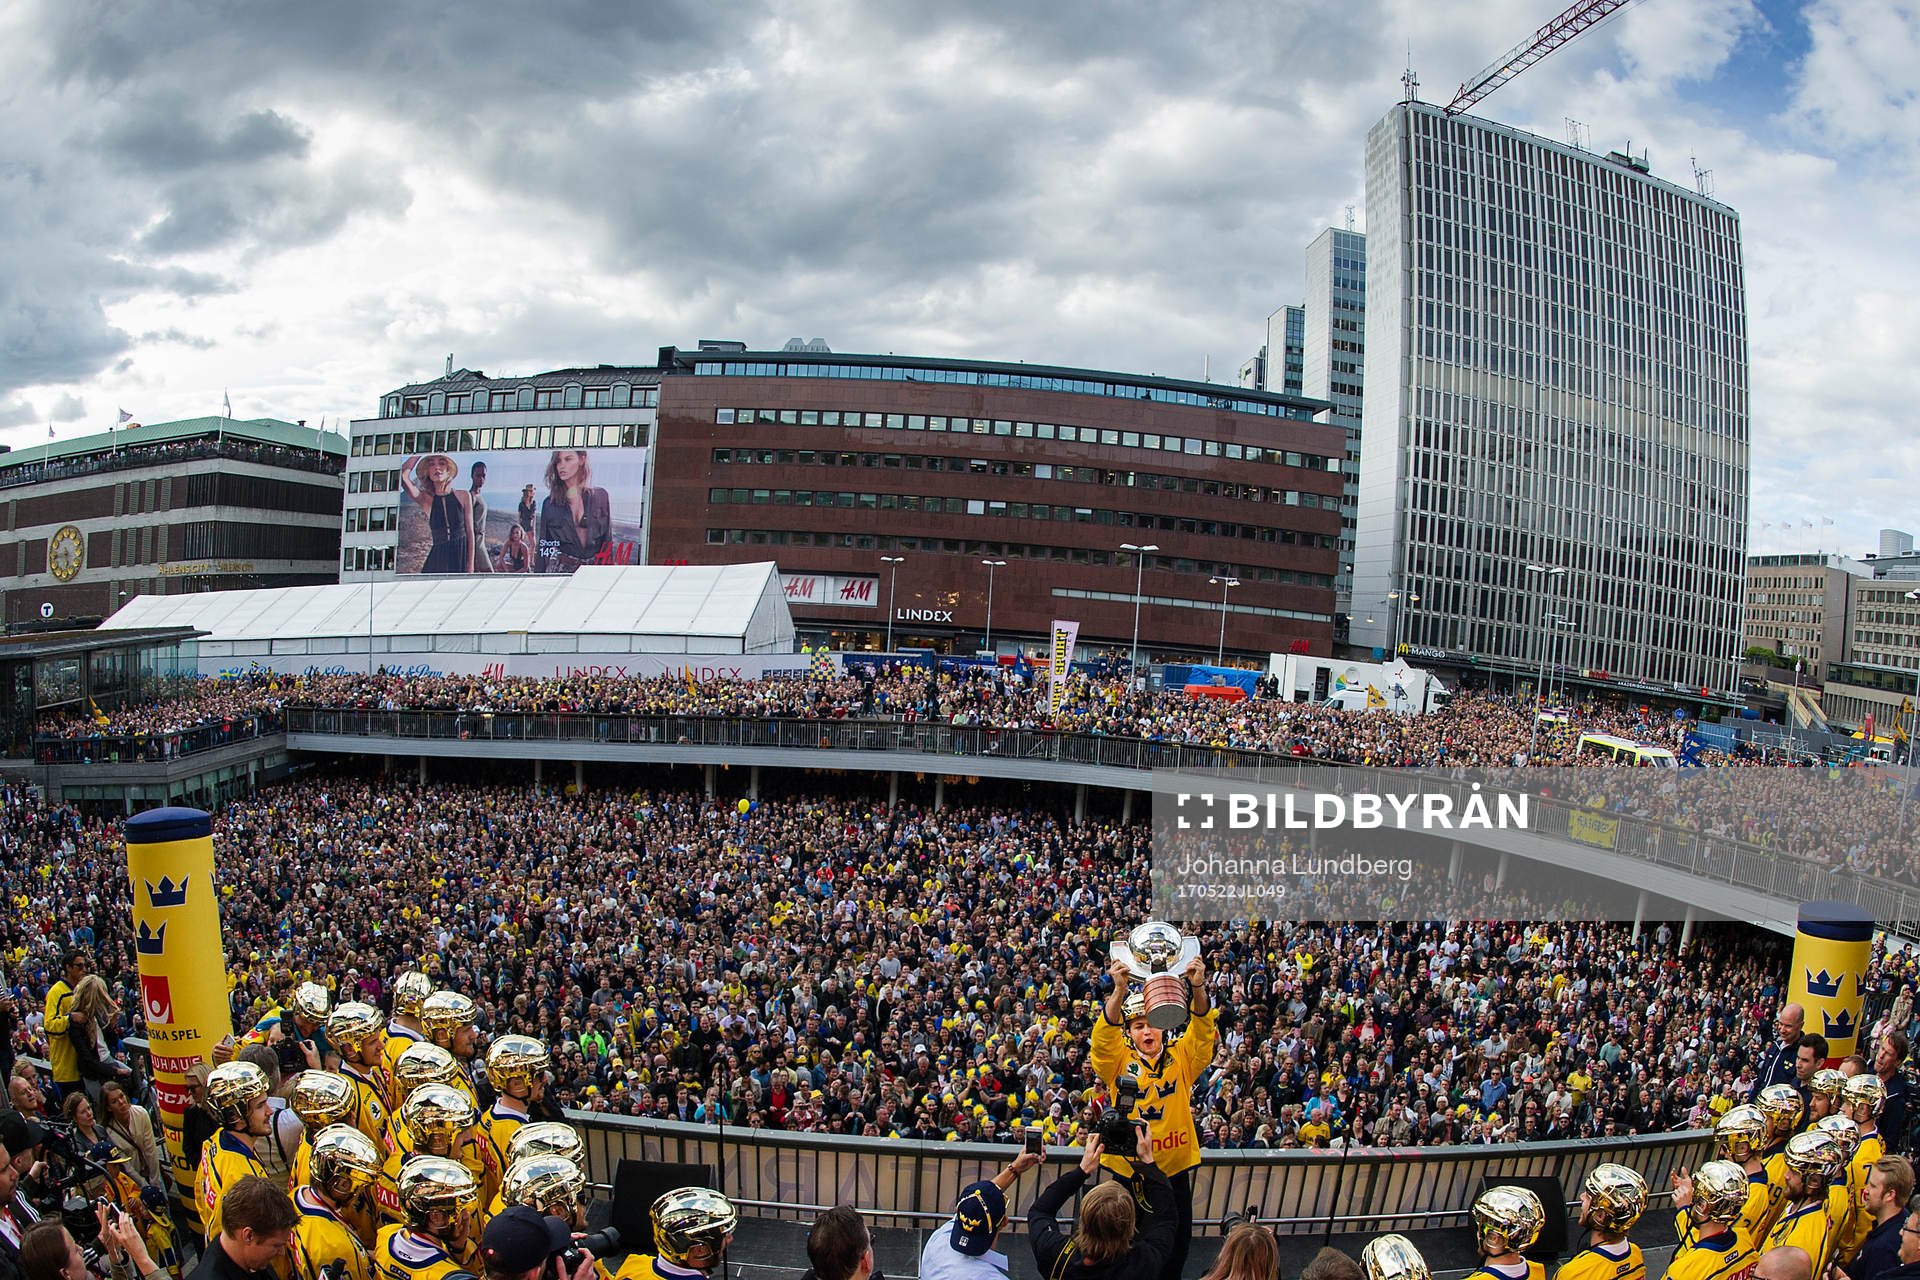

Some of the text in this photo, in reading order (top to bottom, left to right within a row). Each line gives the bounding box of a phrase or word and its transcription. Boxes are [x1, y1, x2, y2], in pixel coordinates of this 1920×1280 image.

[595, 541, 633, 565] H&M
[785, 577, 815, 599] H&M
[840, 579, 872, 601] H&M
[897, 607, 953, 622] LINDEX
[1055, 628, 1069, 675] SPORT
[1410, 649, 1446, 659] MANGO
[1051, 680, 1063, 722] PORT
[172, 1029, 202, 1042] SPEL
[1151, 1130, 1188, 1152] ndic
[1768, 1183, 1783, 1206] 19
